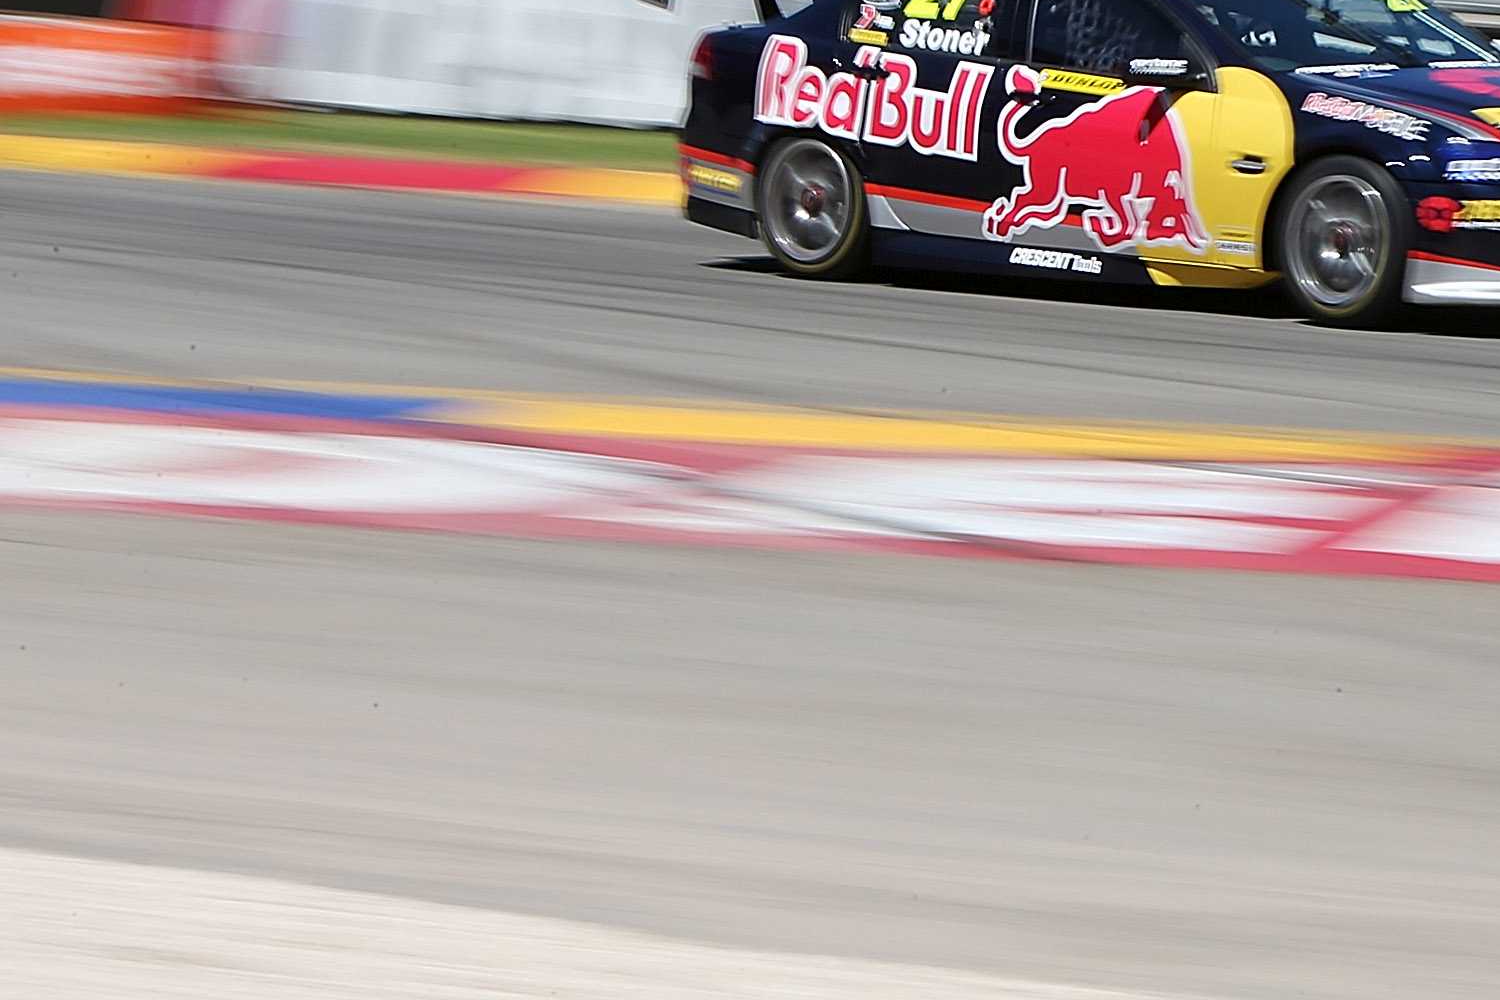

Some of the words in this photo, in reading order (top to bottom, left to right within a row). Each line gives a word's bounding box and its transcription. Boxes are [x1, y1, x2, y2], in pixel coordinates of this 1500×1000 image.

[899, 18, 991, 56] Stoner
[1051, 74, 1125, 91] DUNLOP
[1009, 247, 1074, 269] CRESCENT
